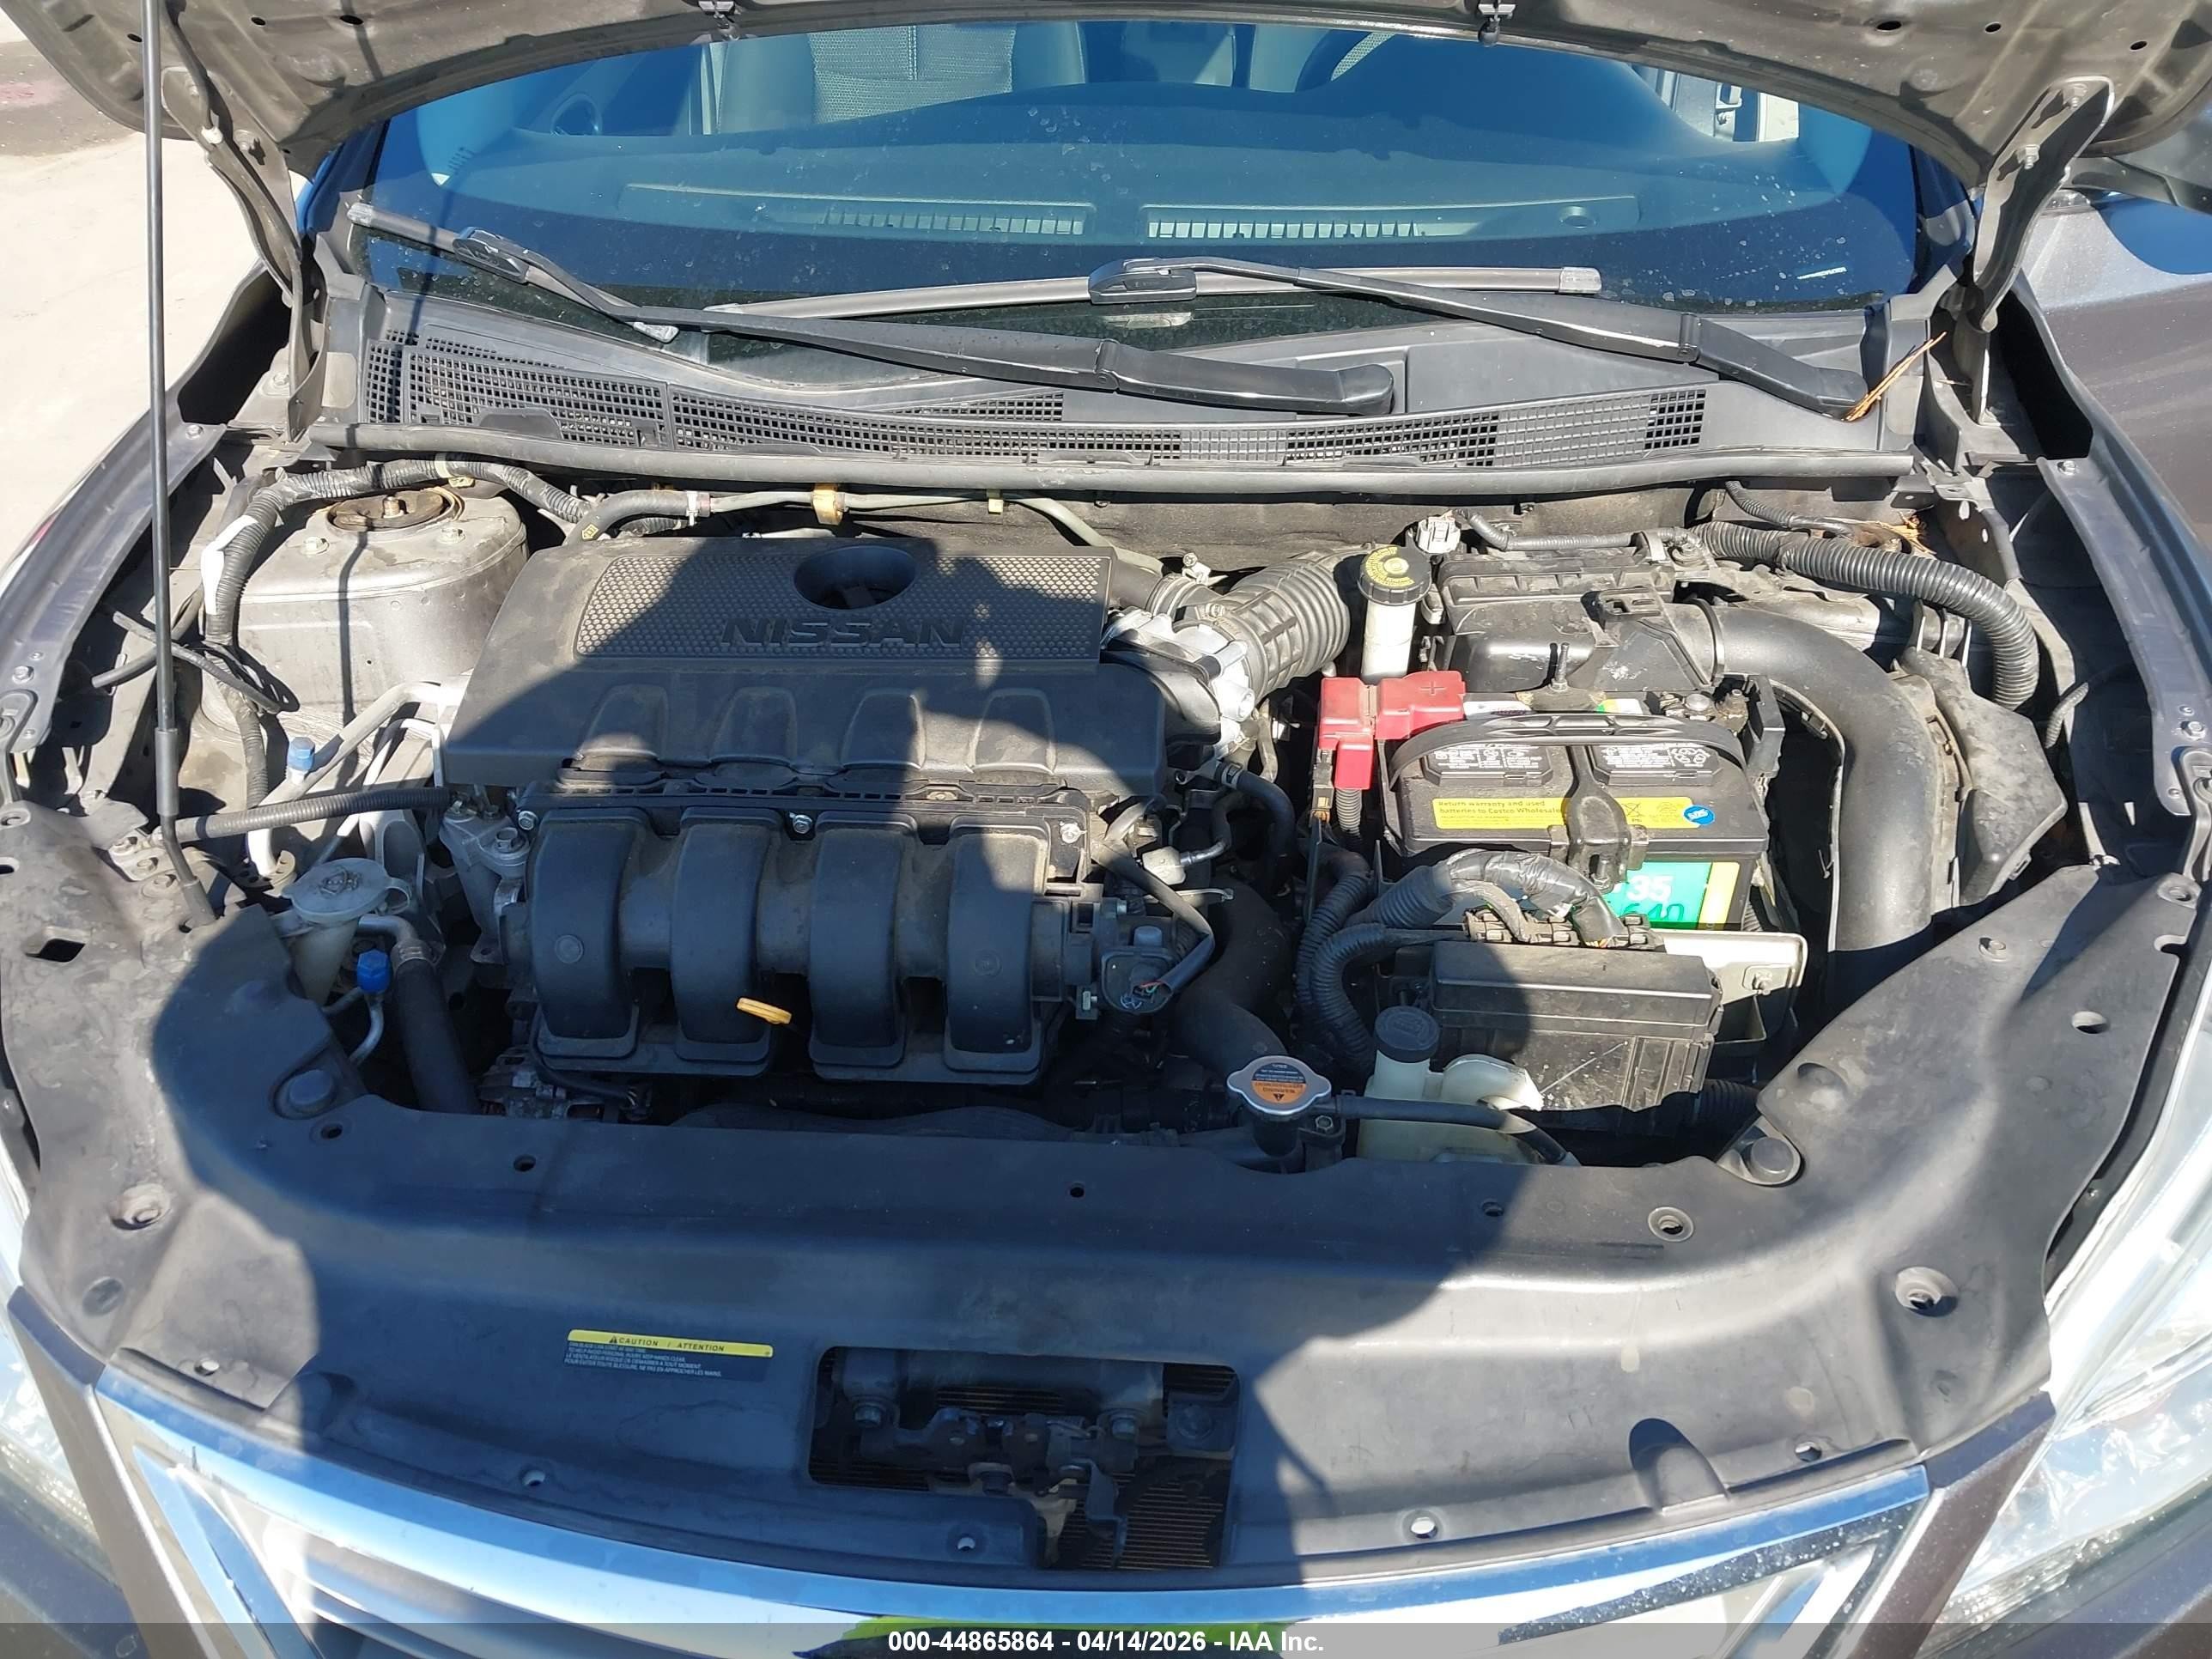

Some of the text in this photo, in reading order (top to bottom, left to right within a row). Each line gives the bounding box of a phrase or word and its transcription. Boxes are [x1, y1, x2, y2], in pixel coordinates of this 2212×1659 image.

[721, 618, 963, 646] NISSAN
[1626, 874, 1674, 902] 35
[618, 1336, 659, 1346] CAUTION
[678, 1342, 725, 1352] ATTENTION
